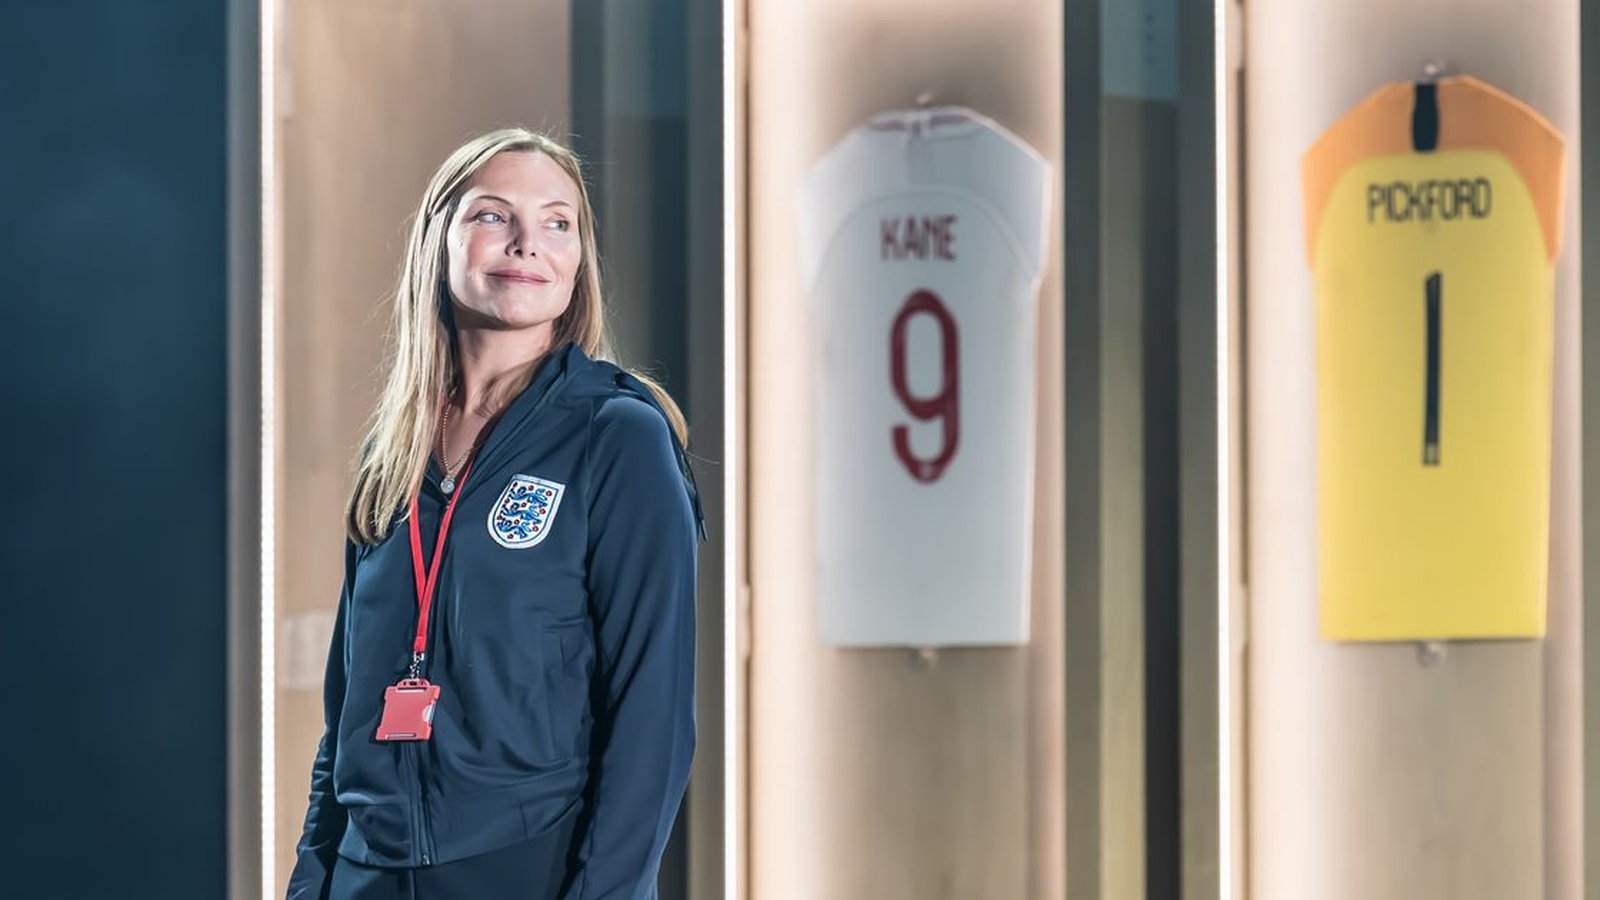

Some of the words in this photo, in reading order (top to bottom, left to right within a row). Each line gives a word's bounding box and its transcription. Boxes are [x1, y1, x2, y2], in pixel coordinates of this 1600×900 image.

[880, 214, 958, 262] KANE
[1367, 177, 1492, 223] PICKFORD
[889, 288, 961, 485] 9
[1422, 271, 1443, 467] 1
